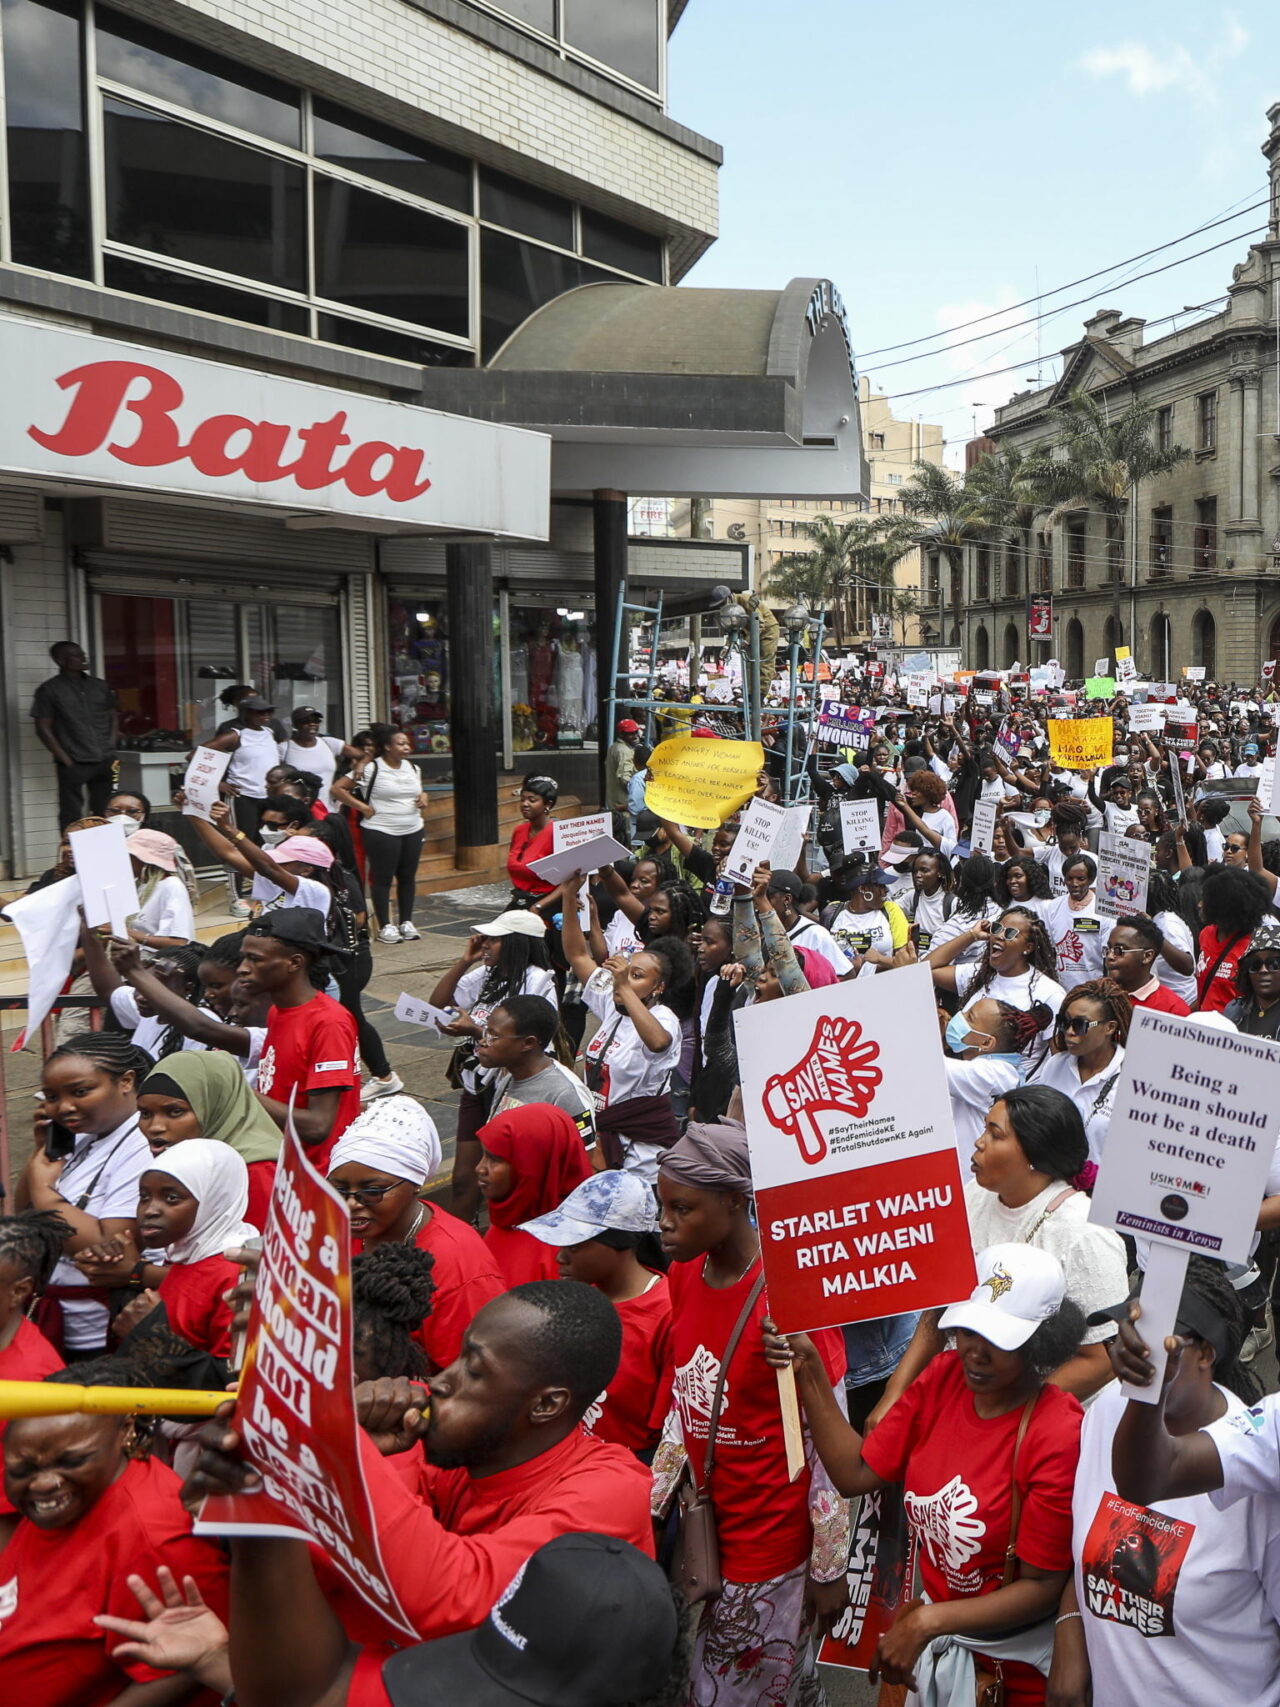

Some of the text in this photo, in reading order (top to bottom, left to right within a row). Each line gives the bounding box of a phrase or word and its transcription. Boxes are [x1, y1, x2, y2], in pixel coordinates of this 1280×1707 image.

[27, 360, 431, 502] Bata
[681, 744, 710, 756] ANGRY
[818, 726, 869, 749] WOMEN
[586, 817, 605, 825] NAMES
[744, 826, 771, 843] KILLING
[755, 817, 771, 828] STOP
[846, 817, 874, 826] KILLING
[1101, 855, 1120, 865] EDUCATE
[1122, 861, 1135, 869] YOUR
[784, 1022, 859, 1110] SAY THEIR NAMES
[1170, 1064, 1239, 1095] Being a
[1131, 1079, 1268, 1129] Woman should
[829, 1115, 896, 1135] #SayTheirNames
[830, 1125, 895, 1145] #EndFemicideKE
[831, 1126, 934, 1154] #TotalShutdownKE Again!
[1128, 1108, 1257, 1152] not be a death
[1148, 1139, 1225, 1169] sentence
[770, 1185, 953, 1241] STARLET WAHU
[1117, 1212, 1221, 1249] Feminists in Kenya
[319, 1235, 339, 1276] a
[796, 1222, 935, 1269] RITA WAENI
[822, 1261, 917, 1298] MALKIA
[256, 1256, 338, 1391] Should
[259, 1344, 309, 1416] not
[253, 1384, 323, 1479] be a
[250, 1433, 349, 1539] death
[913, 1483, 957, 1560] SAY NAMES
[1107, 1499, 1185, 1538] #EndFemicideKE
[847, 1530, 879, 1646] THEIR
[1087, 1574, 1164, 1619] SAY THEIR
[1089, 1591, 1164, 1634] NAMES
